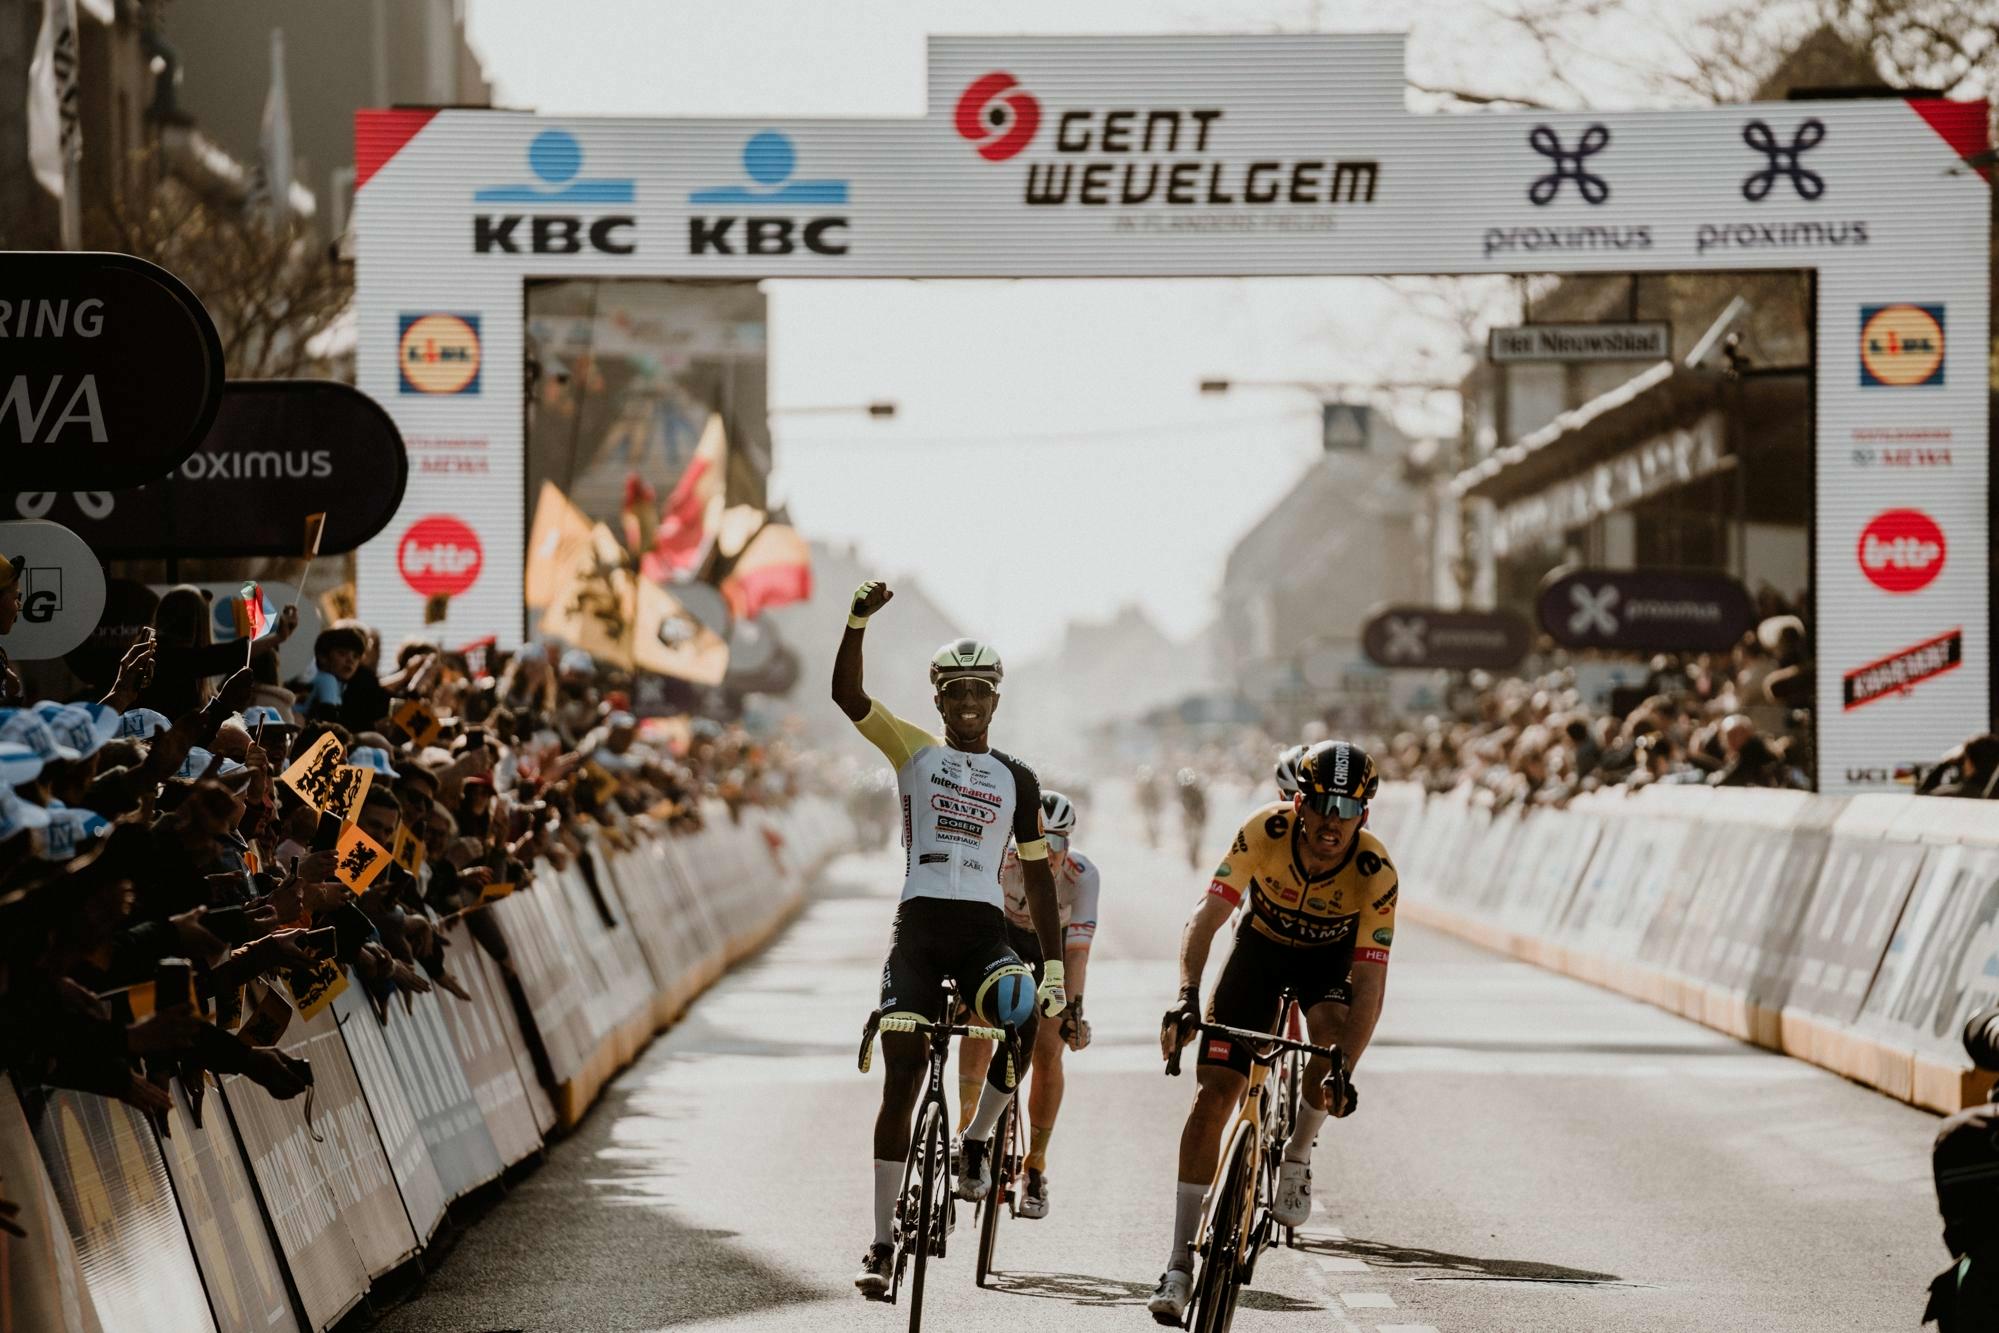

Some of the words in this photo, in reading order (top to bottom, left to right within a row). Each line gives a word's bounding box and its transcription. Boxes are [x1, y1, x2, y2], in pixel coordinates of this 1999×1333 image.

[1056, 110, 1225, 153] GENT
[1025, 161, 1380, 206] WEVELGEM
[473, 214, 638, 256] KBC
[688, 215, 850, 256] KBC
[1484, 225, 1654, 259] proximus
[1696, 220, 1870, 256] proximus
[1846, 767, 1888, 784] UCI
[939, 798, 988, 819] WANTY
[939, 817, 982, 834] GOBERT
[932, 1053, 942, 1092] CUBE
